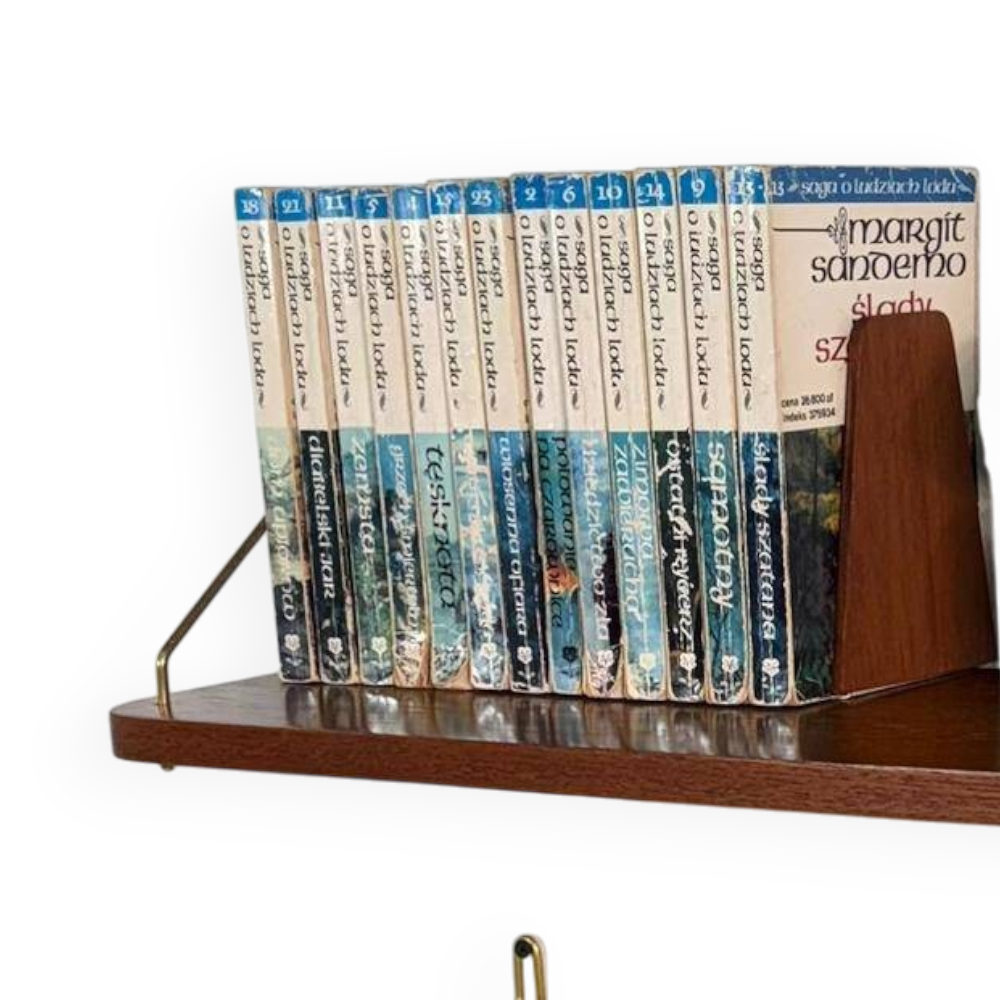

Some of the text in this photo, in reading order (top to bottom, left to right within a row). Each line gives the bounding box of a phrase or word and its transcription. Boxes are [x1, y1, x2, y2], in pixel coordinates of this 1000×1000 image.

[241, 199, 259, 214] 18
[282, 199, 301, 214] 21
[325, 196, 344, 210] 11
[366, 198, 379, 213] 5
[471, 190, 492, 206] 23
[524, 187, 537, 201] 2
[562, 186, 577, 203] 6
[596, 186, 622, 201] 10
[645, 183, 665, 201] 14
[691, 179, 706, 198] 9
[772, 178, 957, 199] 13 saga o ludziach lodu
[401, 226, 411, 239] o
[597, 215, 609, 230] o
[643, 212, 655, 227] o
[849, 211, 966, 253] margit
[258, 250, 271, 299] saga
[299, 252, 312, 301] saga
[344, 247, 357, 297] saga
[380, 249, 394, 300] saga
[420, 250, 433, 300] saga
[453, 246, 466, 296] saga
[490, 246, 503, 297] saga
[539, 241, 553, 293] saga
[574, 240, 589, 294] saga
[599, 235, 620, 332] ludziach
[618, 240, 632, 294] saga
[645, 233, 664, 331] ludziach
[663, 239, 676, 292] saga
[706, 237, 721, 291] saga
[751, 237, 764, 292] saga
[811, 250, 967, 283] sandemo
[240, 226, 265, 387] o ludziach lodu
[283, 227, 308, 389] o ludziach lodu
[361, 225, 388, 389] o ludziach lodu
[402, 245, 421, 338] ludziach
[472, 221, 498, 388] o ludziach lodu
[520, 215, 546, 385] o ludziach lodu
[554, 215, 581, 387] o ludziach lodu
[687, 210, 699, 225] o
[696, 336, 711, 386] lodu
[337, 340, 351, 385] lodu
[447, 340, 462, 386] lodu
[352, 435, 375, 555] zemsta
[552, 436, 576, 571] polowanie
[629, 441, 653, 559] zimowa
[426, 446, 456, 609] tęsknota
[500, 438, 527, 636] wiosenna ofiara
[538, 437, 563, 628] na czarownice
[614, 442, 644, 619] zawierucha
[706, 441, 734, 609] samotny
[751, 441, 777, 641] ślady szatana
[320, 553, 336, 600] jar
